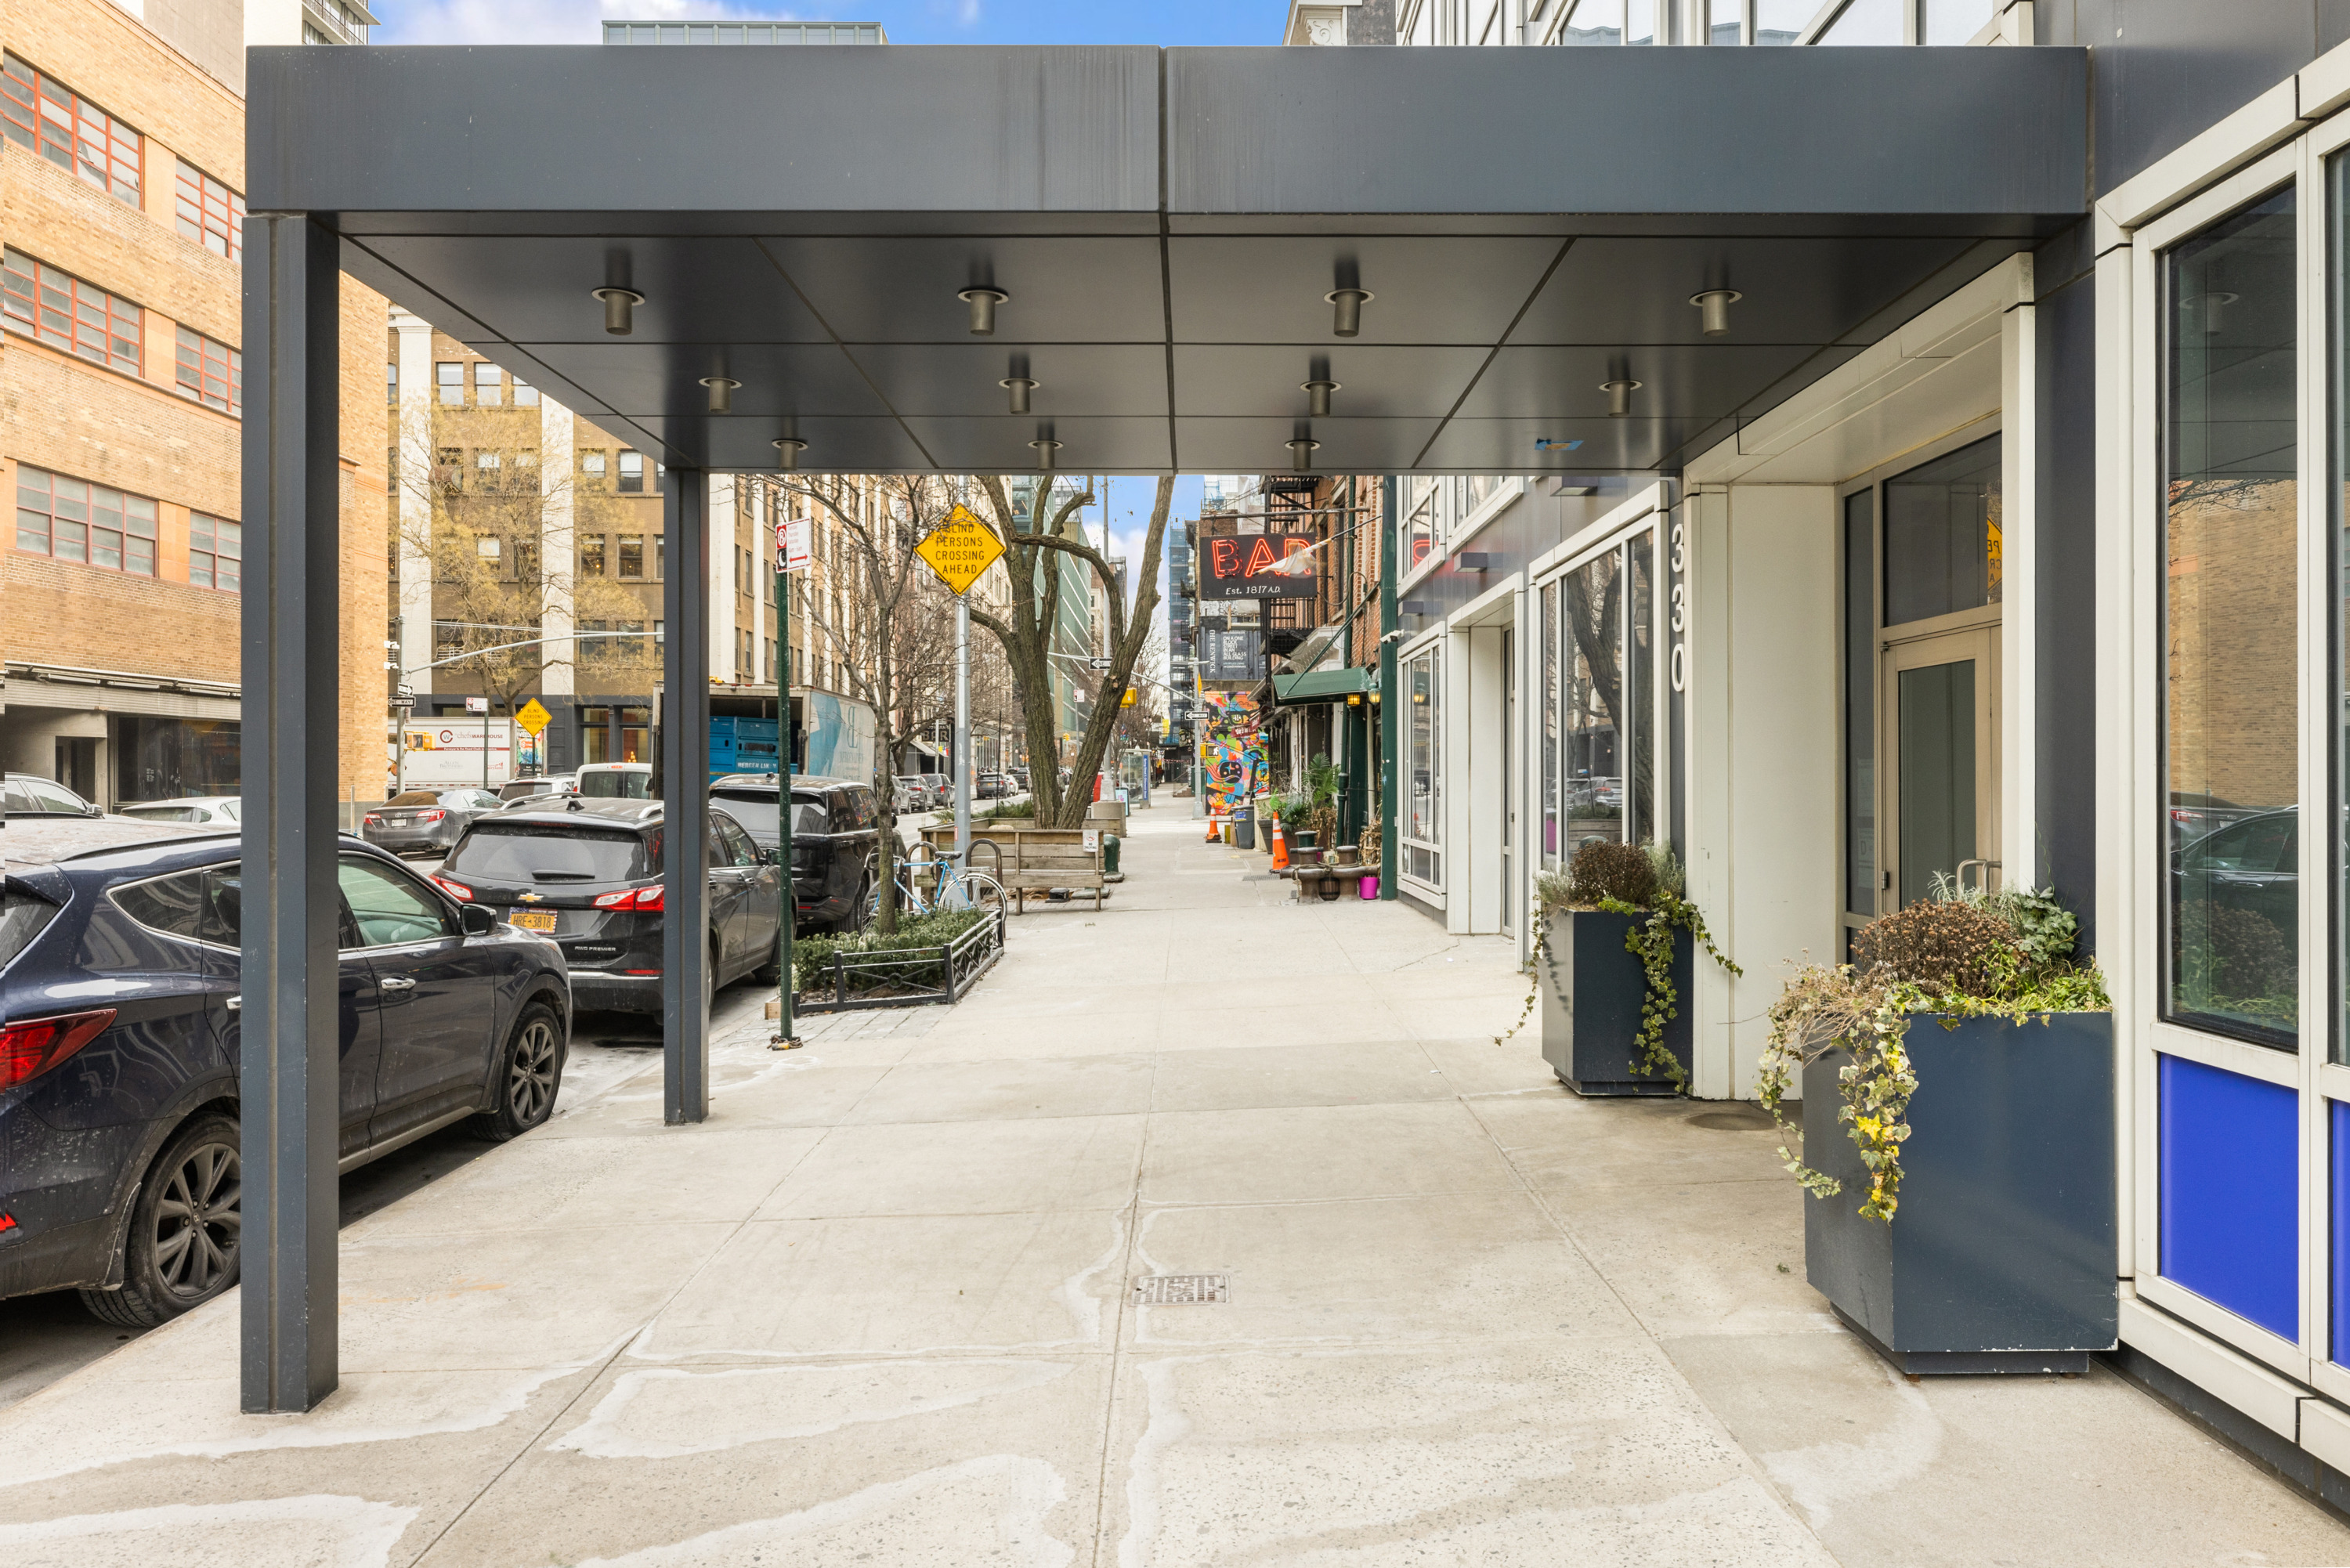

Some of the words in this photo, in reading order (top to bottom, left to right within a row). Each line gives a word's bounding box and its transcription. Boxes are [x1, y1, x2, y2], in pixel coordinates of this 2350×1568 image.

[936, 537, 982, 547] PERSONS
[935, 551, 985, 561] CROSSING
[942, 565, 977, 574] AHEAD
[1246, 585, 1267, 594] 1817
[923, 730, 949, 741] BAR
[513, 915, 527, 927] HRE
[533, 916, 551, 927] 3818
